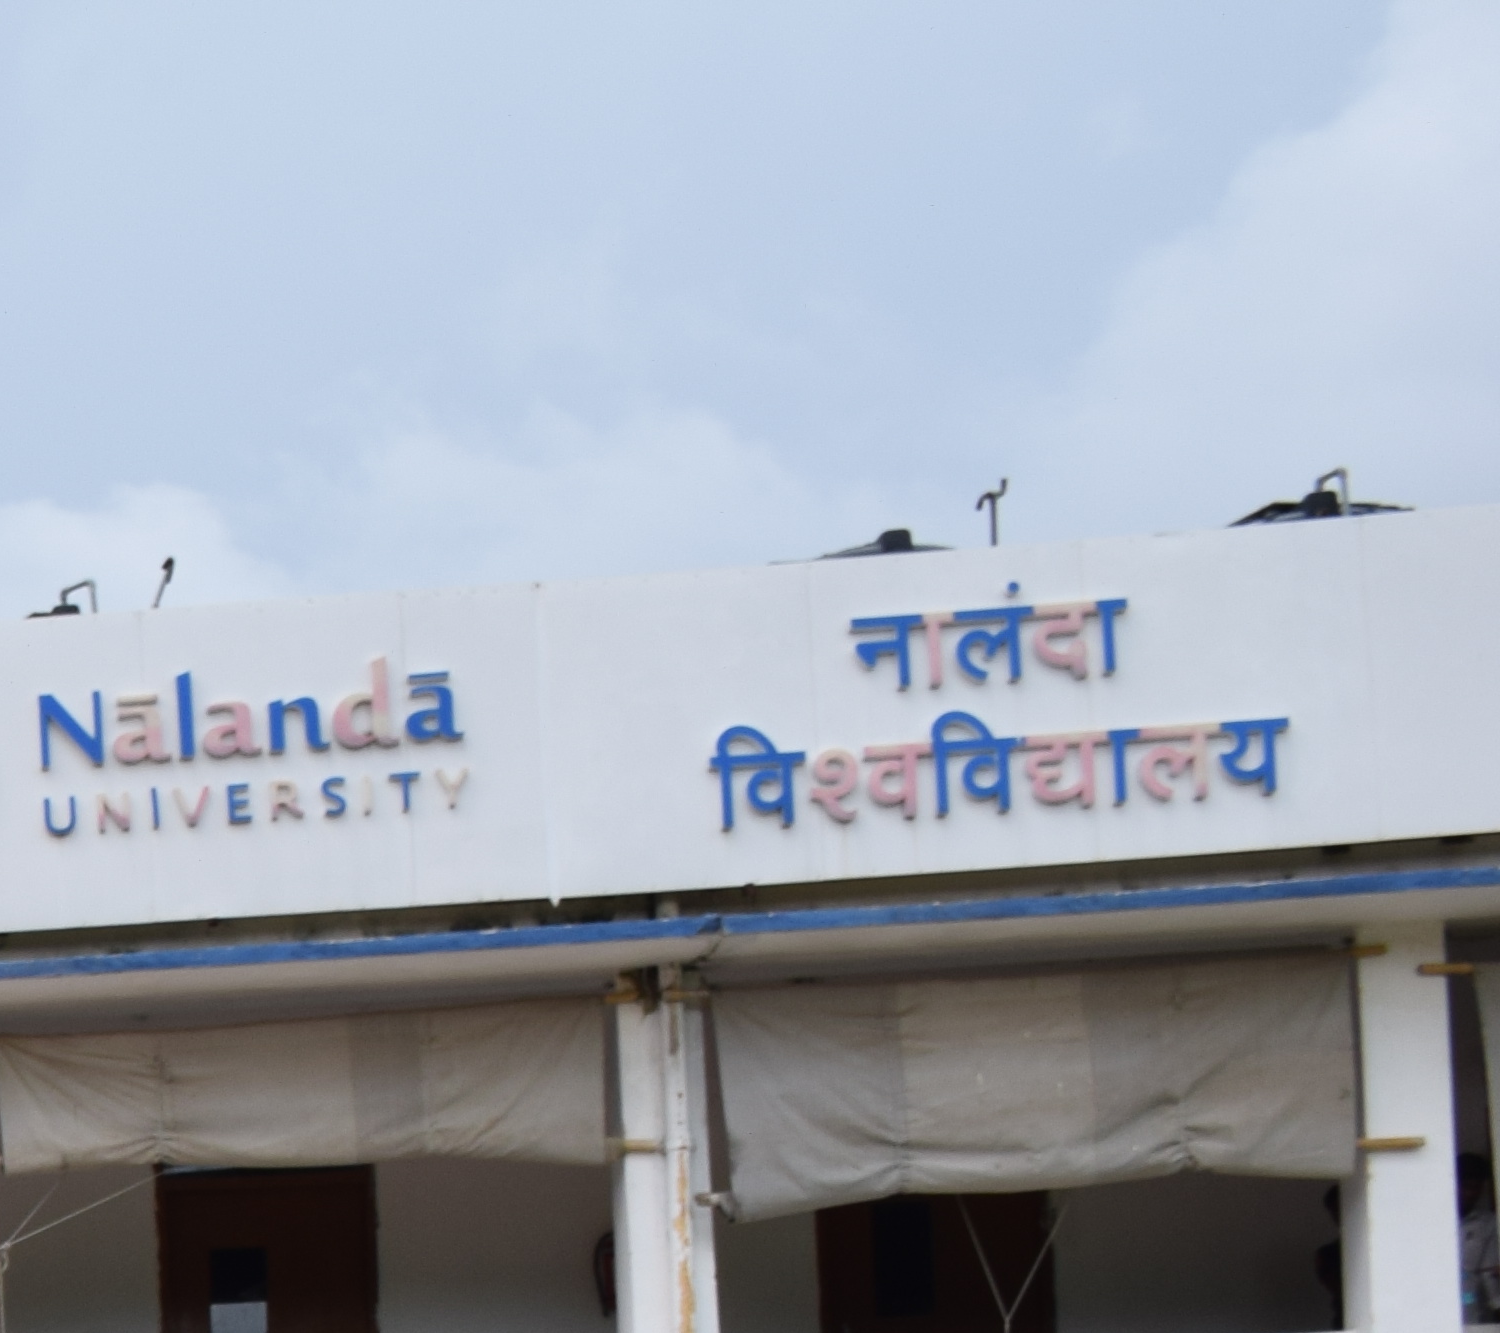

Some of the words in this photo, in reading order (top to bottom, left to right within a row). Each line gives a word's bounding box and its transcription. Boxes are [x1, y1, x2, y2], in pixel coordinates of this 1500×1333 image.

[849, 580, 1128, 691] नालंदा
[36, 656, 466, 773] Nālandā
[709, 710, 1290, 832] विश्वविद्यालय
[42, 767, 469, 838] UNIVERSITY
